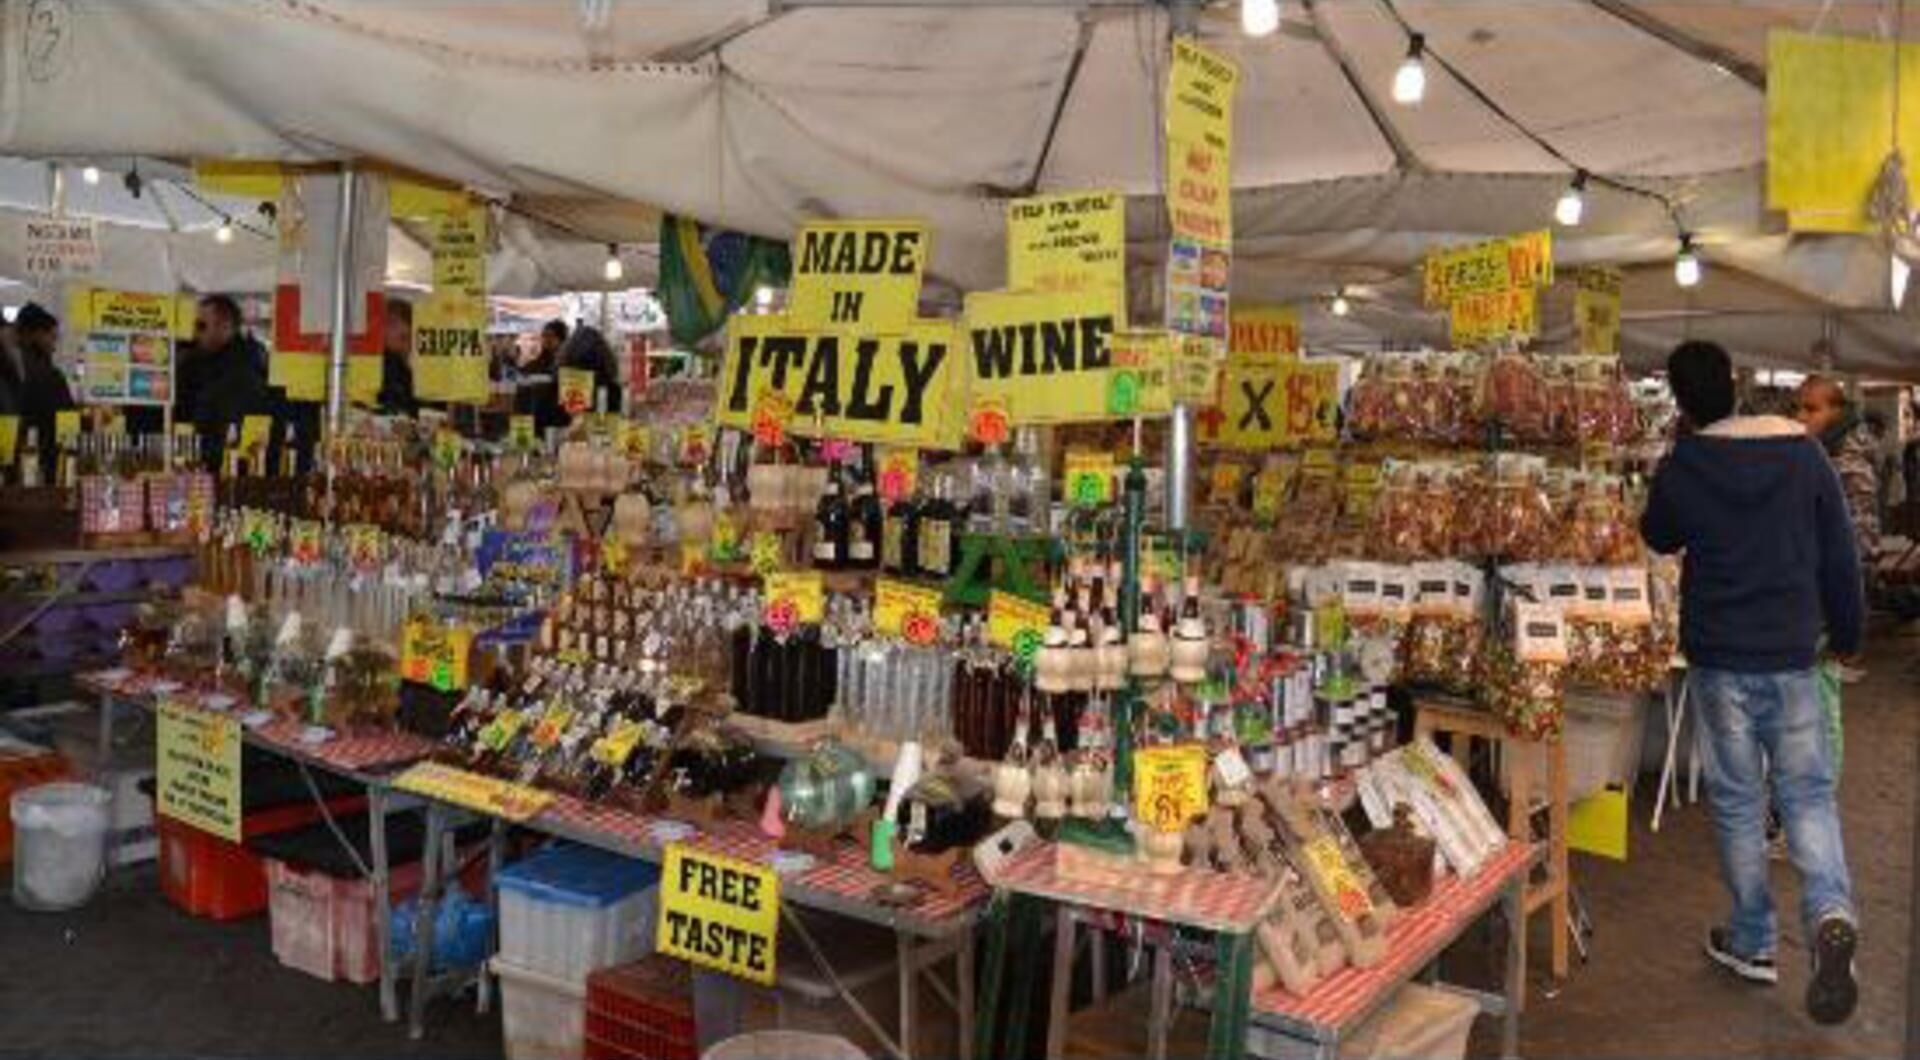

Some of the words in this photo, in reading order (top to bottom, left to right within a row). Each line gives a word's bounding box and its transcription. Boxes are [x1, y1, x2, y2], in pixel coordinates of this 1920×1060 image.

[800, 231, 919, 273] MADE
[830, 291, 863, 322] IN
[971, 314, 1114, 379] WINE
[729, 336, 947, 424] ITALY
[680, 857, 762, 912] FREE
[666, 909, 768, 971] TASTE
